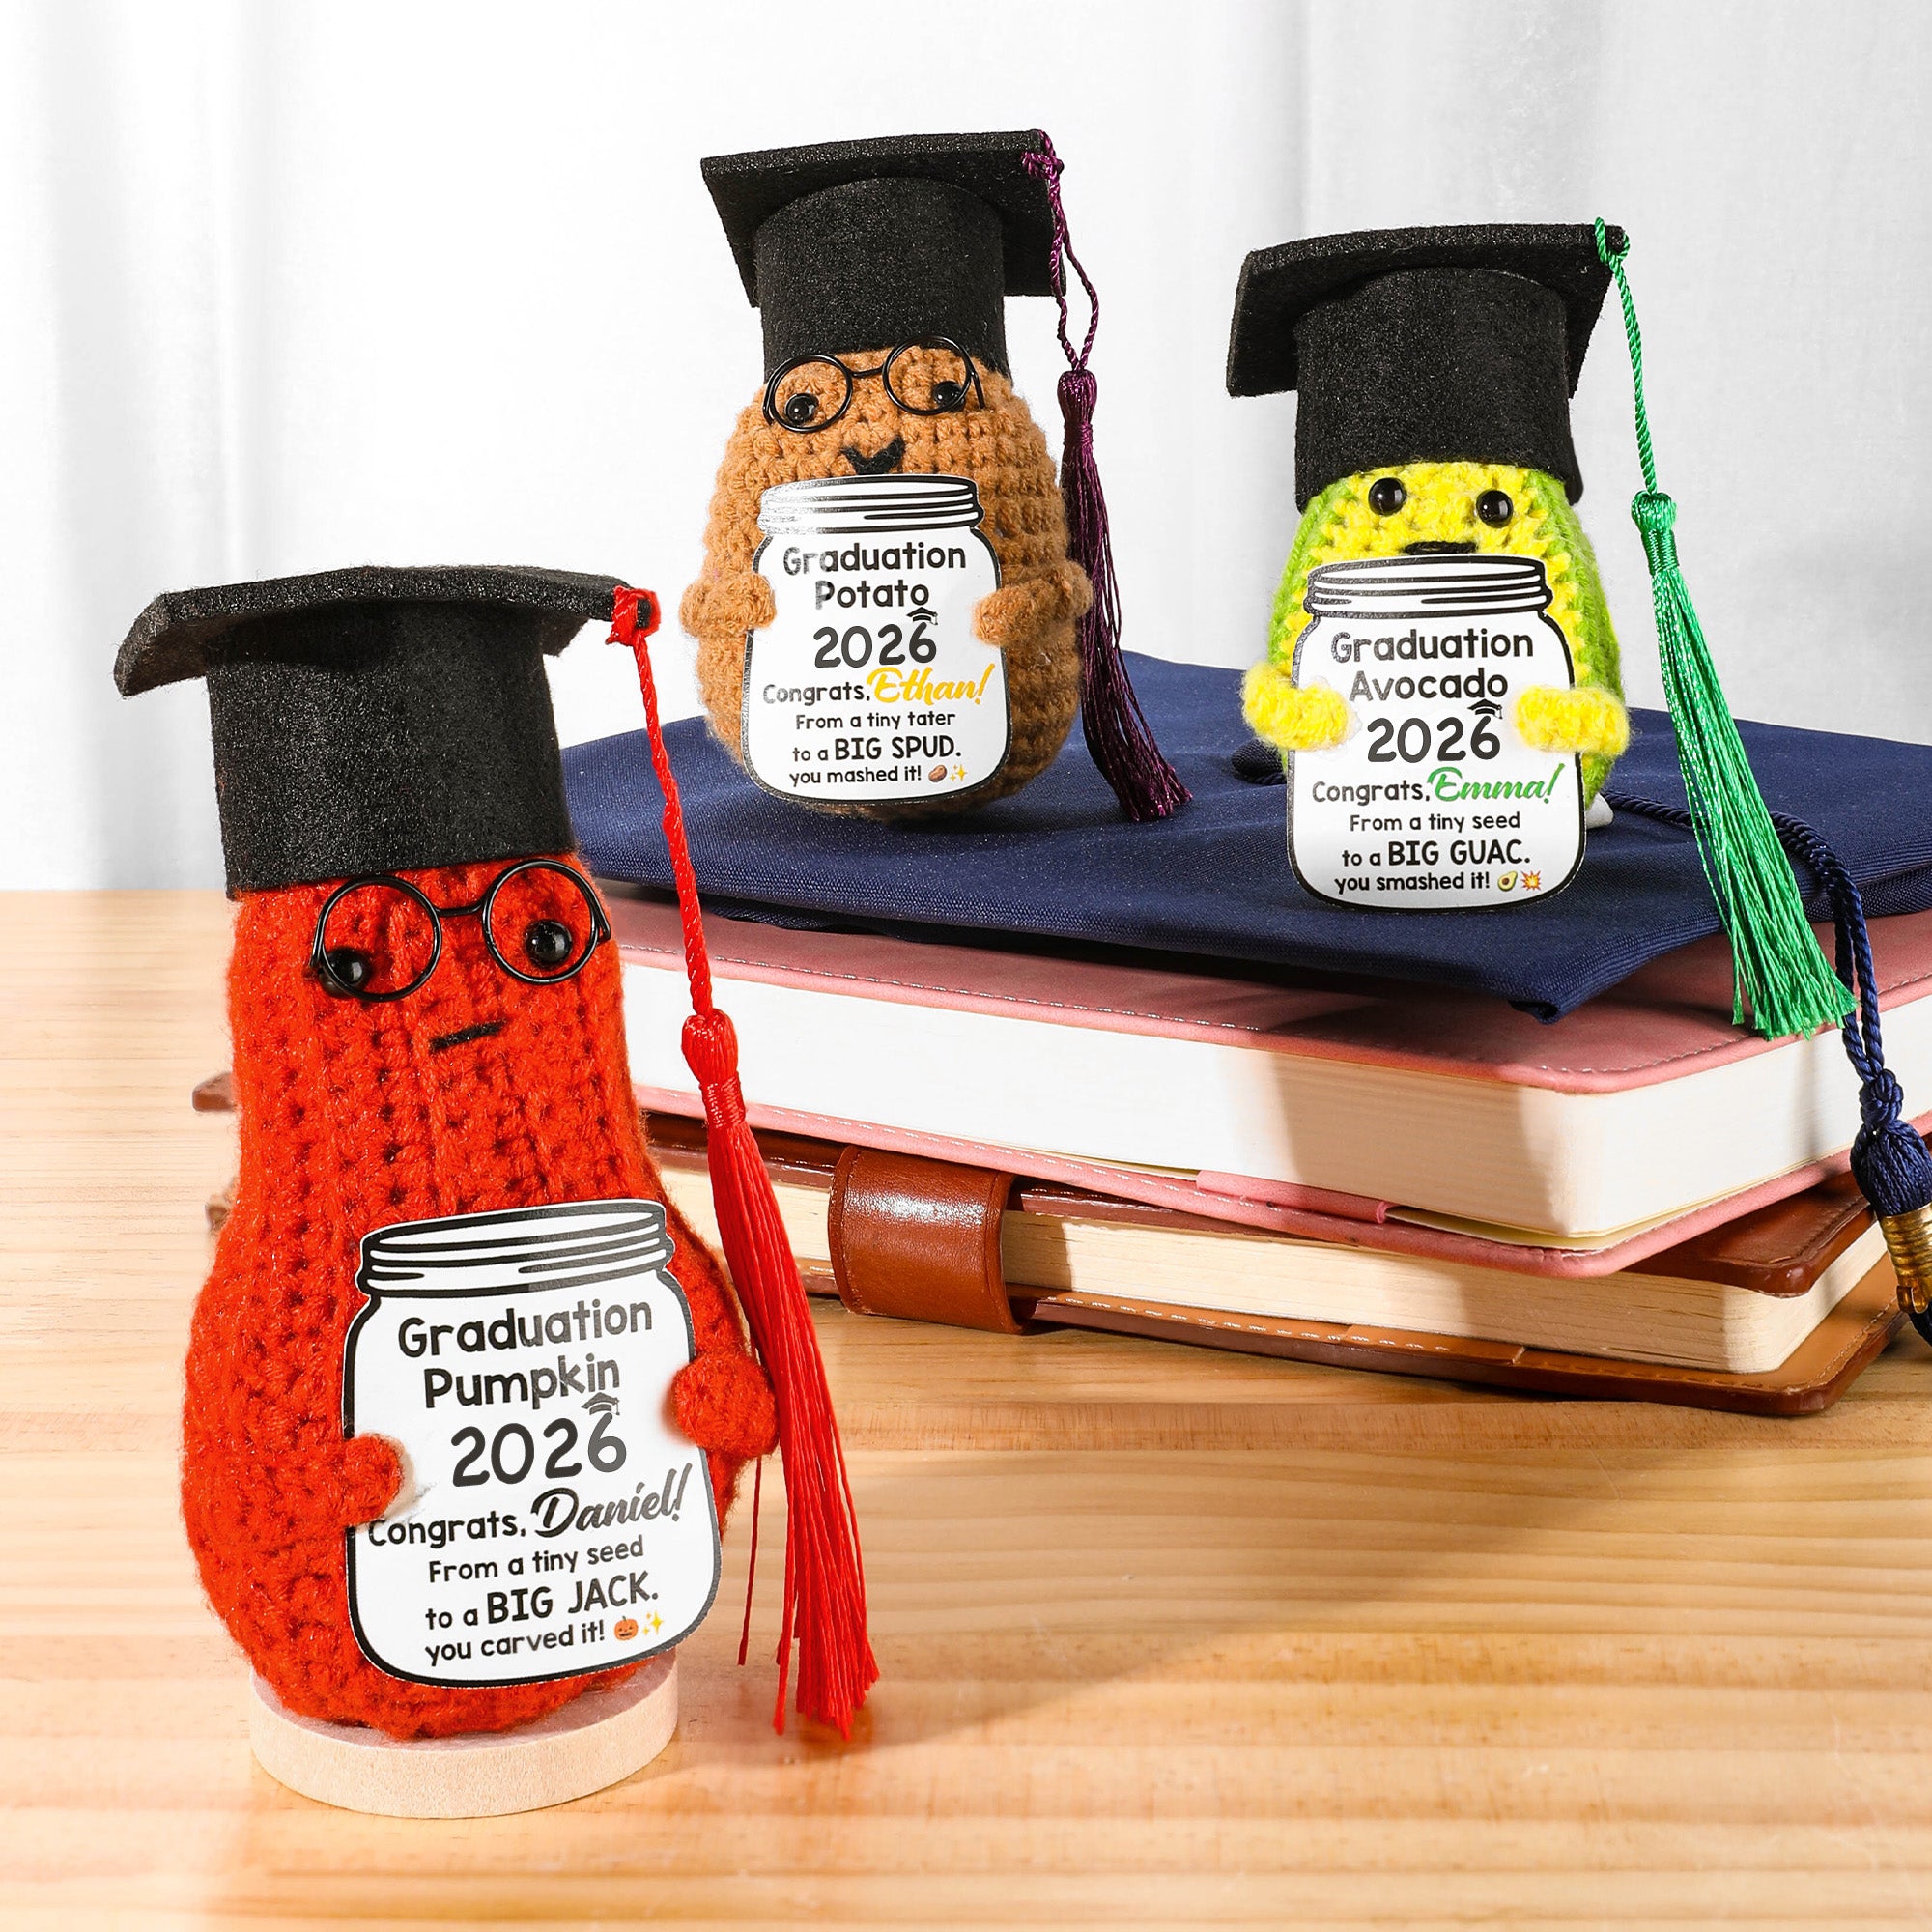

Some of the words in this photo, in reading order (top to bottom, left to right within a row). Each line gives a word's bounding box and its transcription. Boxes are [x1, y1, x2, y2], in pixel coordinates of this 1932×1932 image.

[783, 542, 966, 576] Graduation
[815, 580, 929, 610] Potato
[813, 622, 937, 668] 2026
[1331, 628, 1534, 663] Graduation
[763, 682, 870, 706] Congrats,
[867, 663, 996, 705] Ethan!
[1349, 668, 1508, 701] Avocado
[796, 714, 843, 730] From
[850, 715, 862, 728] a
[867, 712, 901, 729] tiny
[907, 711, 956, 726] tater
[1367, 715, 1500, 763] 2026
[793, 747, 810, 762] to
[817, 748, 828, 761] a
[836, 737, 882, 760] BIG
[892, 735, 961, 758] SPUD.
[789, 770, 821, 787] you
[827, 767, 898, 783] mashed
[904, 766, 922, 781] it!
[1313, 779, 1430, 806] Congrats,
[1427, 763, 1565, 804] Emma!
[1350, 814, 1402, 832] From
[1409, 816, 1421, 830] a
[1429, 813, 1465, 833] tiny
[1472, 811, 1520, 829] seed
[1342, 850, 1362, 867] to
[1370, 852, 1380, 867] a
[1388, 840, 1439, 865] BIG
[1450, 839, 1530, 864] GUAC.
[1334, 876, 1370, 895] you
[1377, 871, 1463, 891] smashed
[1470, 870, 1490, 889] it!
[398, 1299, 652, 1358] Graduation
[423, 1353, 620, 1410] Pumpkin
[450, 1412, 627, 1487] 2026
[368, 1511, 526, 1548] Congrats,
[428, 1560, 497, 1583] From
[508, 1559, 523, 1576] a
[533, 1550, 578, 1575] tiny
[587, 1534, 643, 1562] seed
[425, 1606, 452, 1630] to
[463, 1609, 478, 1628] a
[487, 1589, 553, 1624] BIG
[567, 1571, 659, 1614] JACK.
[424, 1642, 472, 1667] you
[481, 1627, 573, 1657] carved
[582, 1620, 605, 1643] it!
